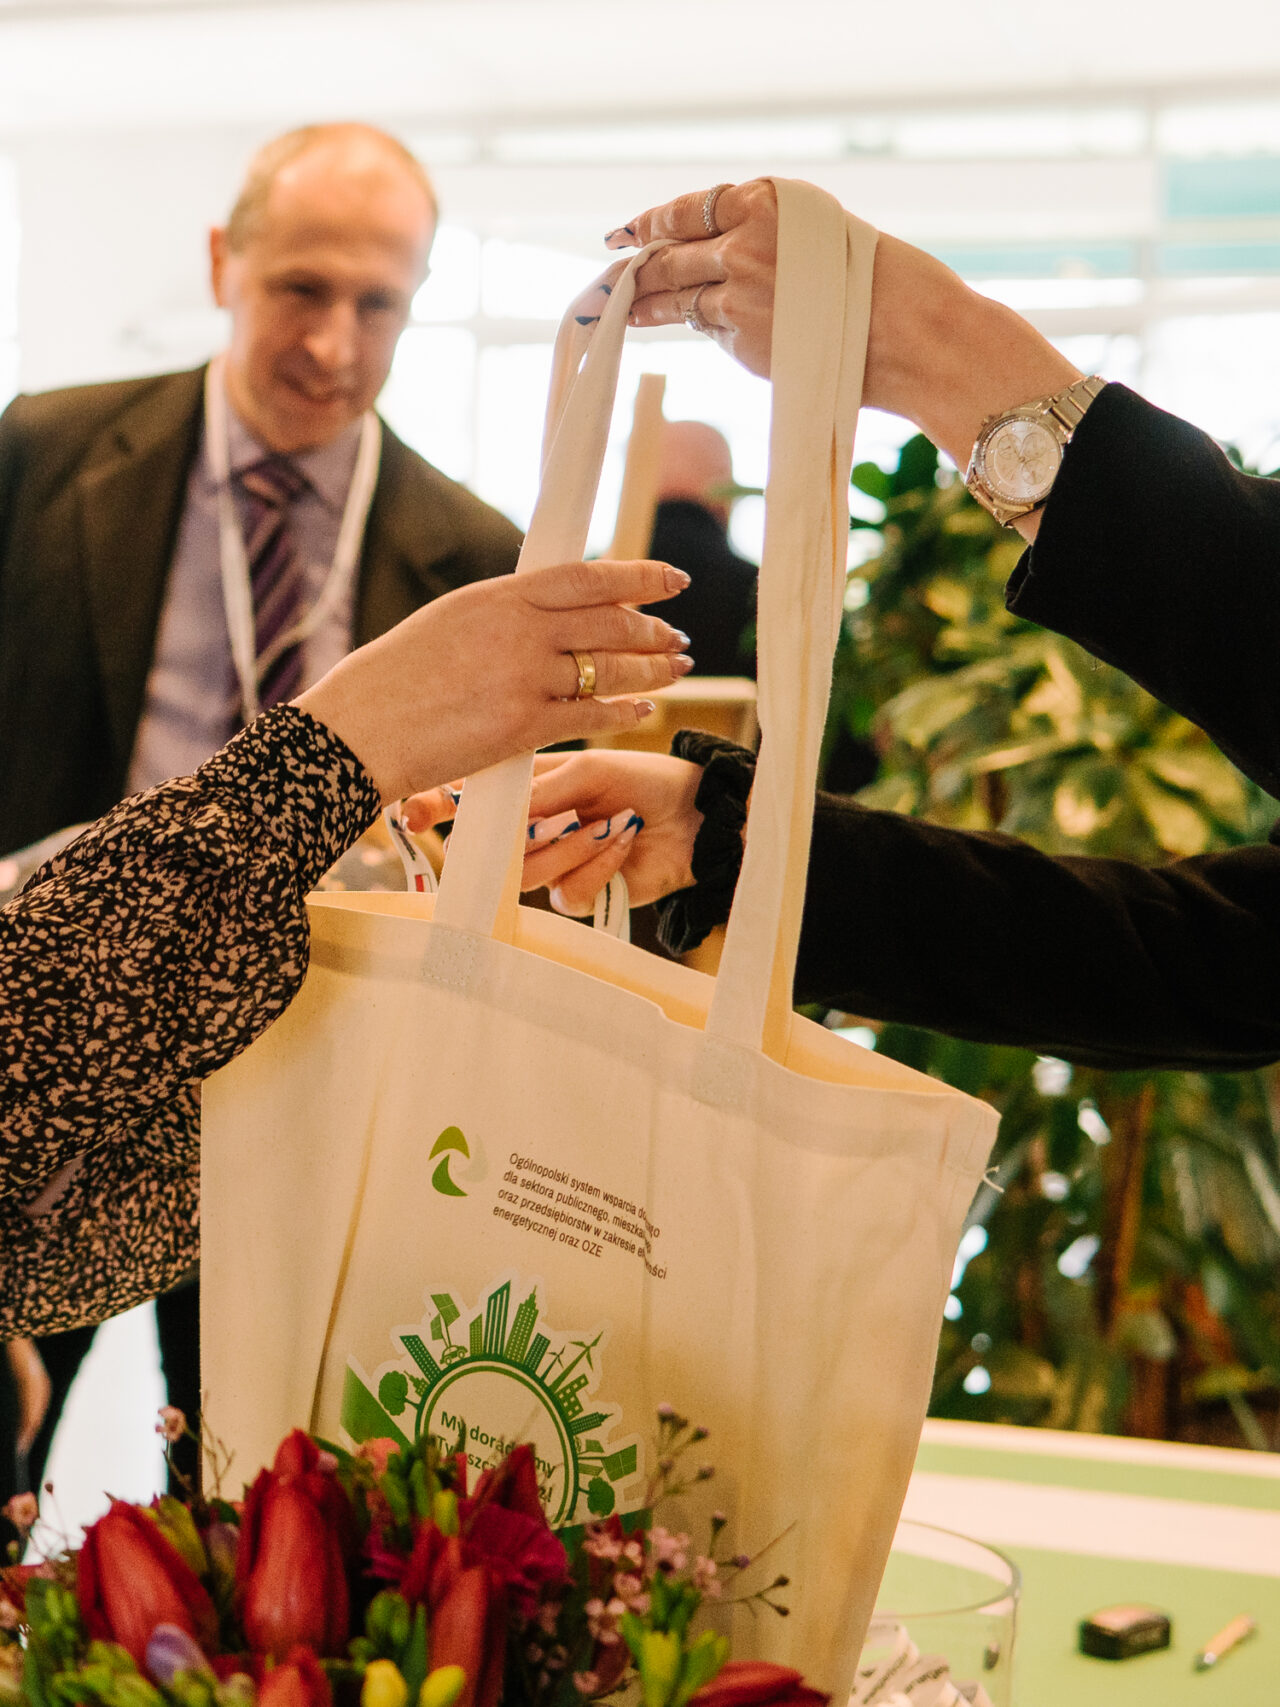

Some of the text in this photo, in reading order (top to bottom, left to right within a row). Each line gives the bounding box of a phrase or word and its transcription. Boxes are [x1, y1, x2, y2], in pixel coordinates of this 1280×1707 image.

[503, 1170, 518, 1185] dla
[520, 1178, 554, 1199] sektora
[555, 1191, 610, 1224] publicznego,
[509, 1152, 636, 1216] Ogólnopolski system wsparcia
[493, 1205, 604, 1258] energetycznej oraz OZE
[498, 1189, 519, 1205] oraz
[593, 1225, 602, 1238] w
[602, 1229, 636, 1255] zakresie
